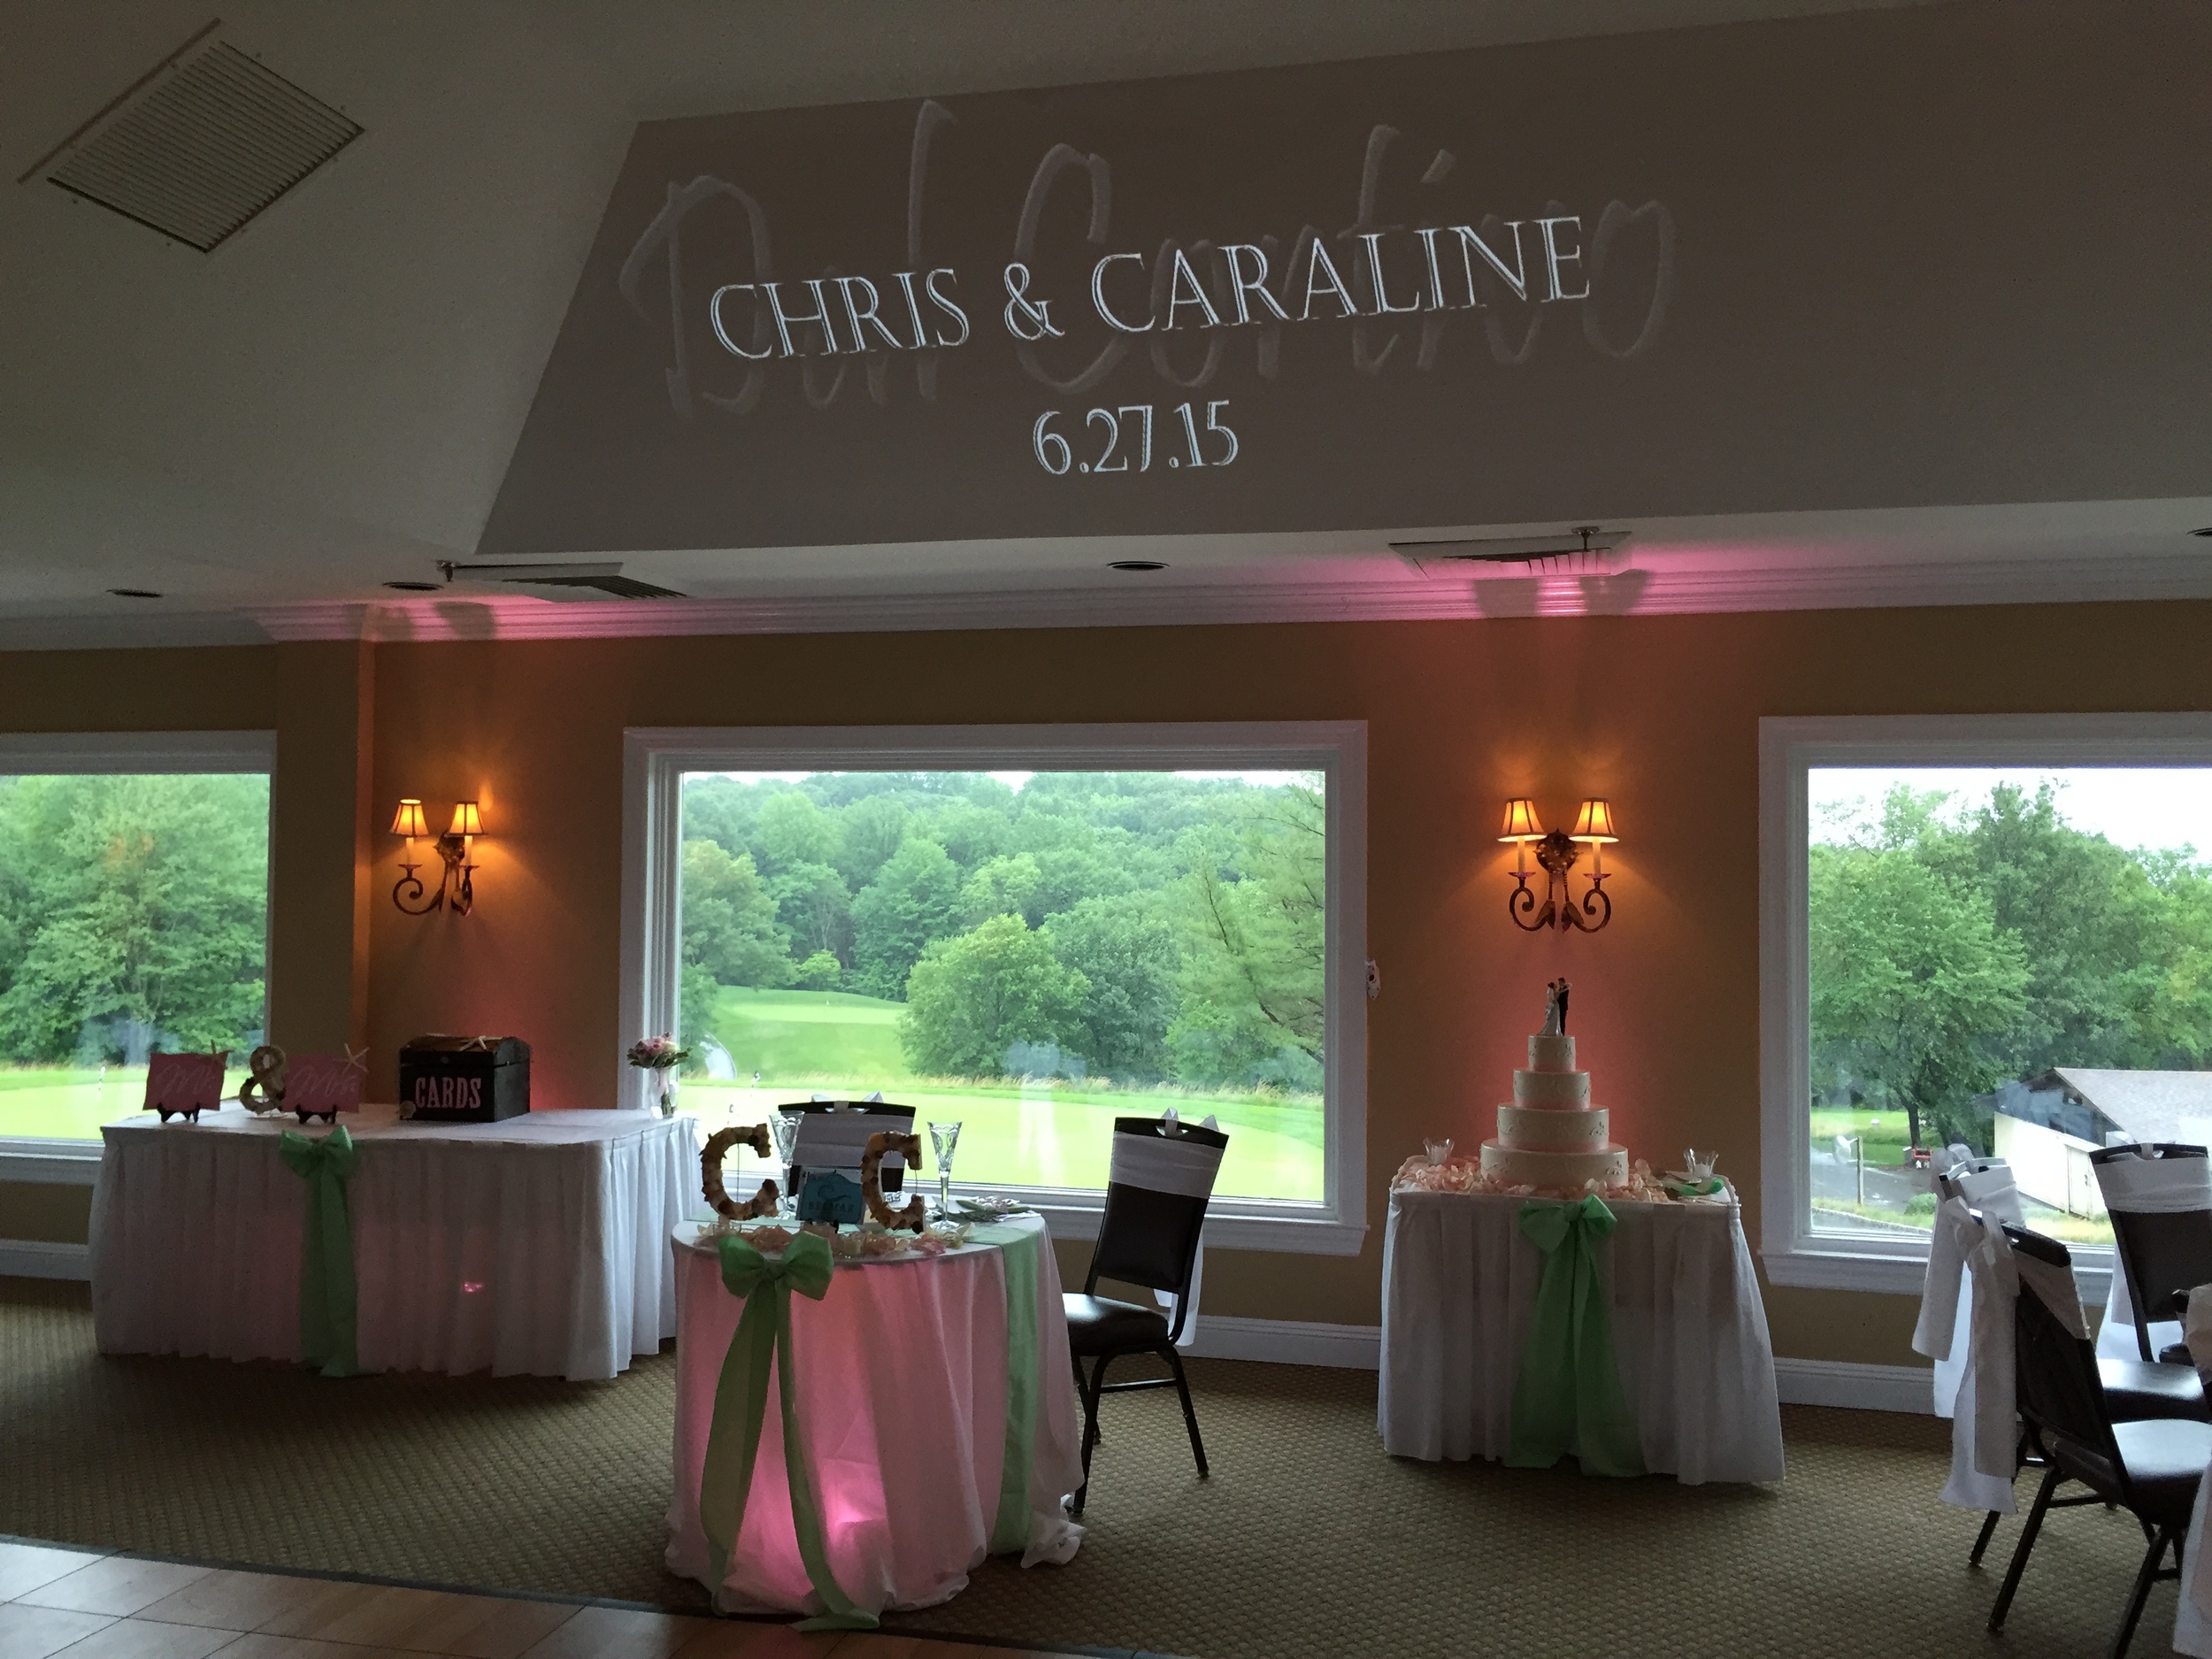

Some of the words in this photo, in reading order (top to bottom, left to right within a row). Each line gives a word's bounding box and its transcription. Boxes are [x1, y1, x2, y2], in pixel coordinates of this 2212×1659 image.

[710, 268, 971, 359] CHRIS
[1003, 262, 1066, 341] &
[1091, 216, 1591, 333] CARALINE
[1033, 401, 1239, 475] 6.27.15
[415, 1077, 481, 1110] CARDS
